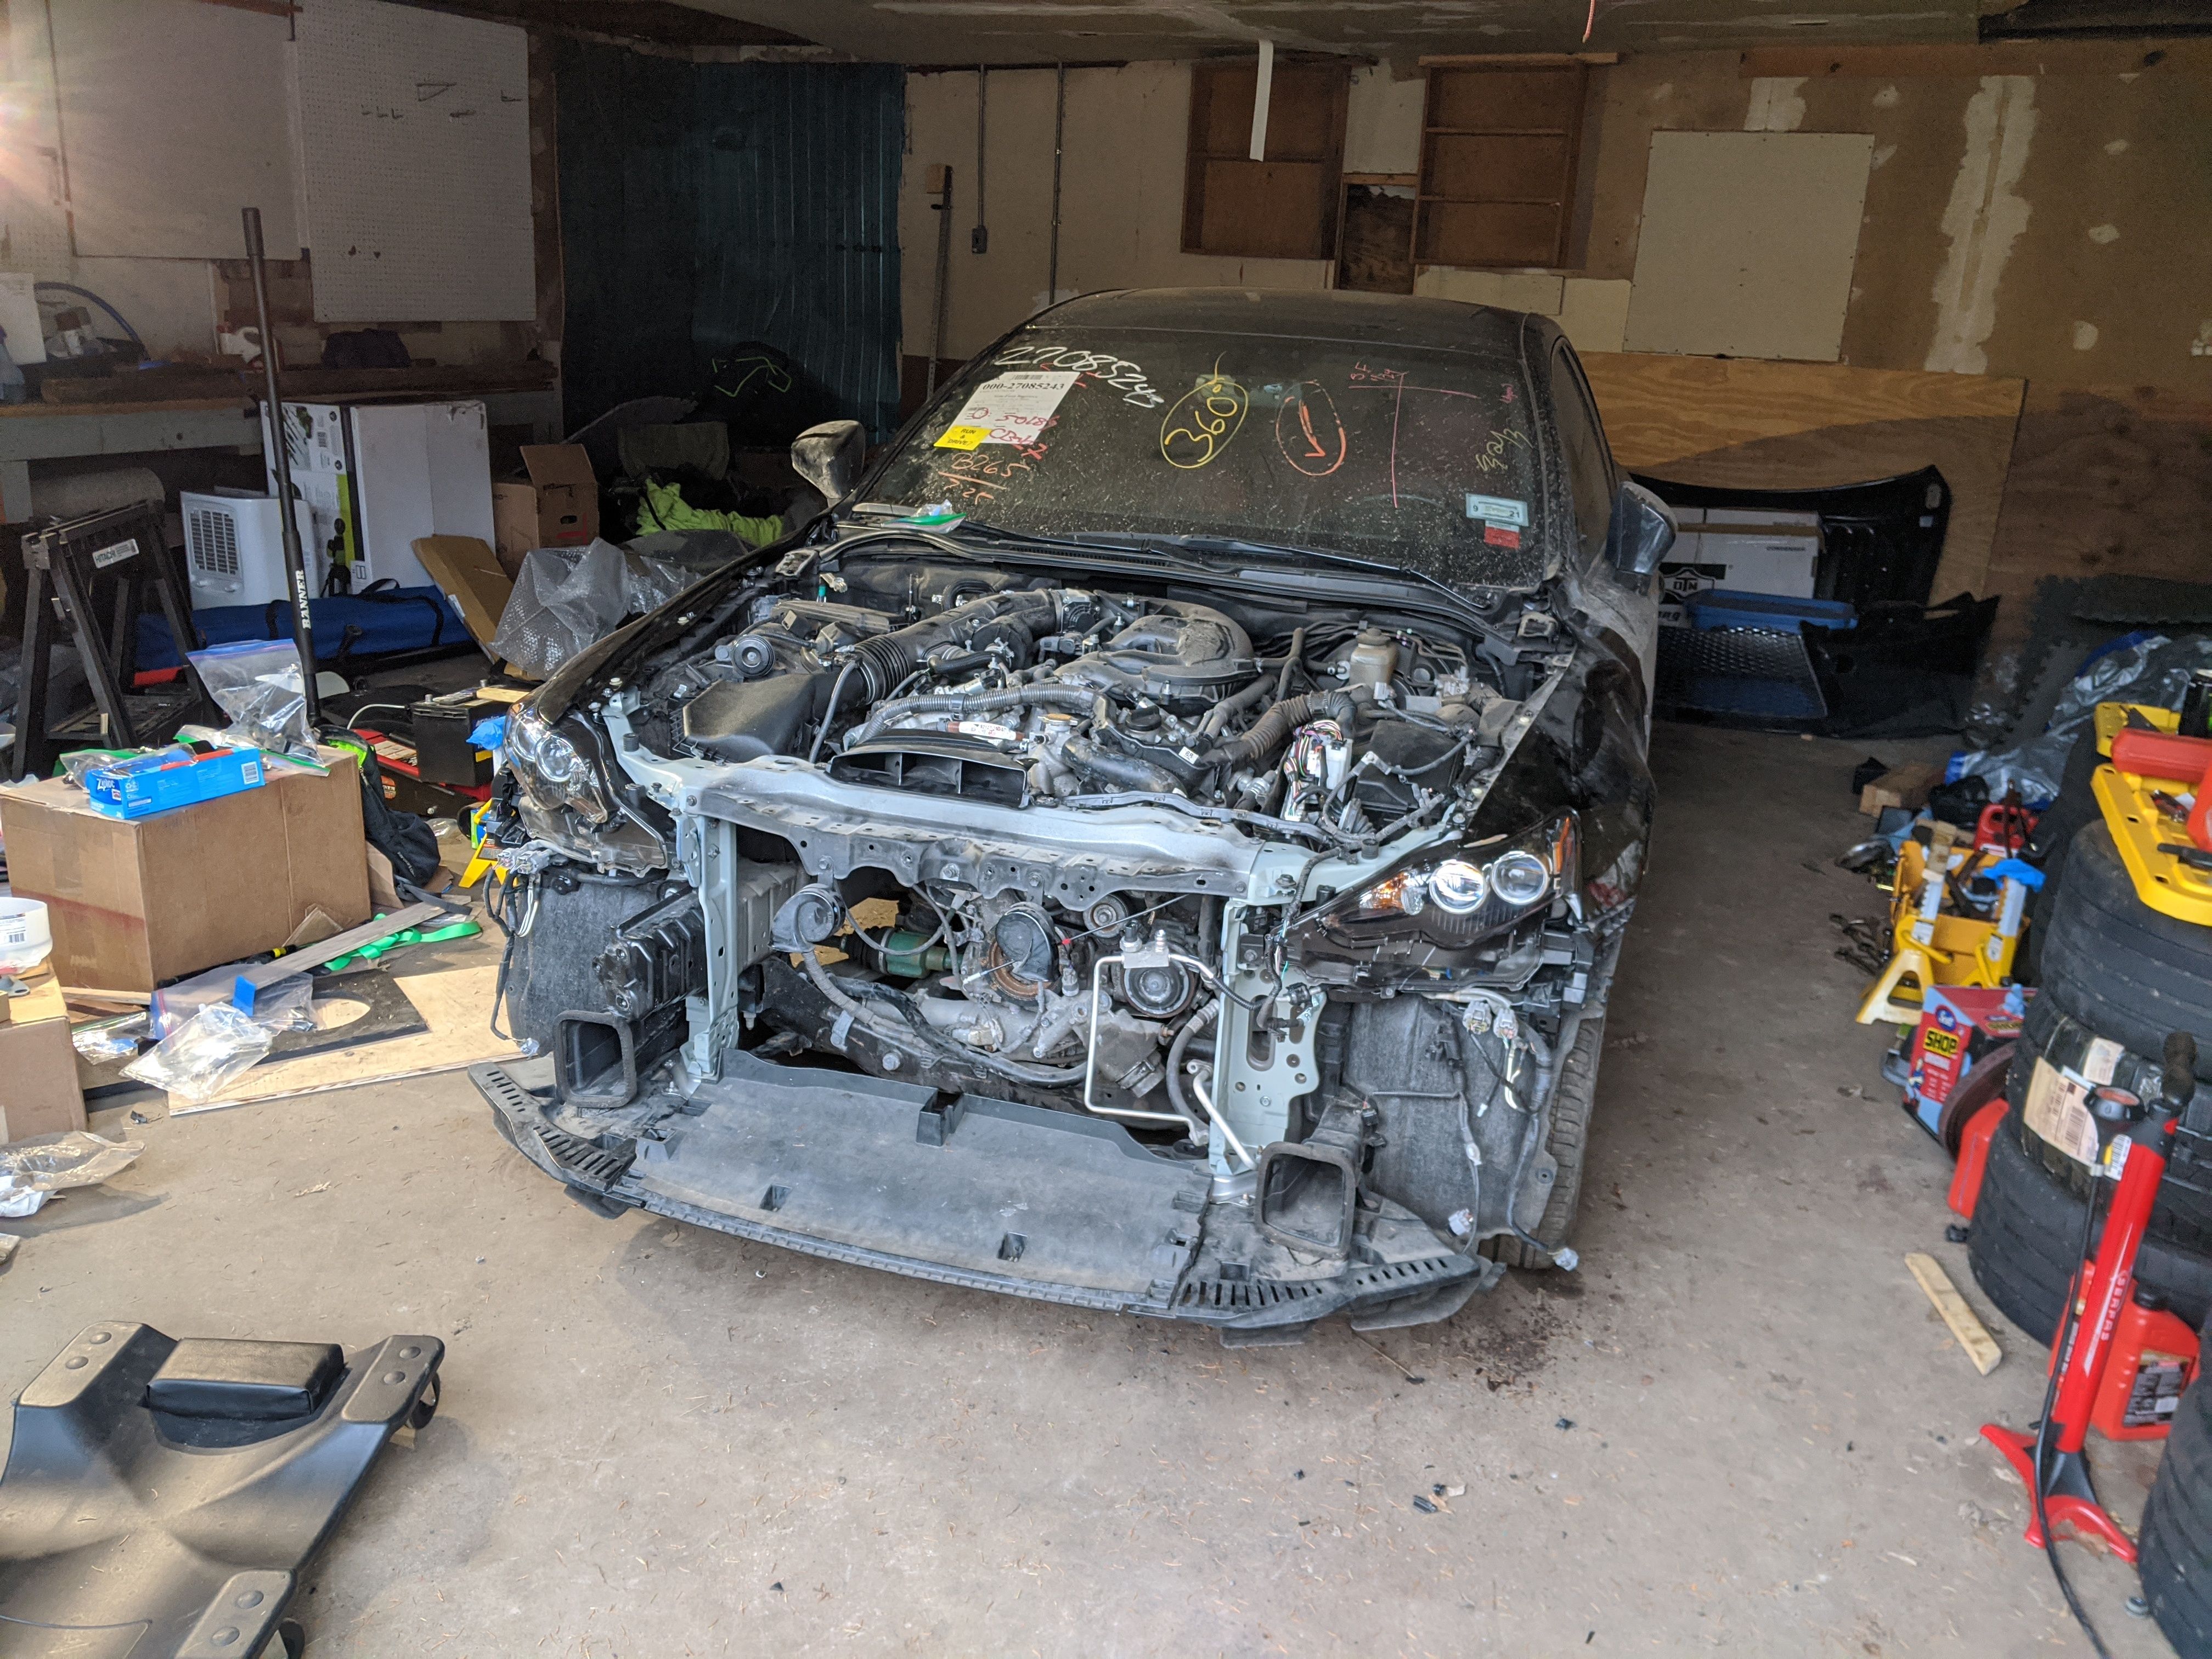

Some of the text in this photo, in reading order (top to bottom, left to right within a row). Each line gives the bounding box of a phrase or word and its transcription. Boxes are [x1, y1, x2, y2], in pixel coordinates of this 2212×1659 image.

[982, 382, 1065, 391] 000-27085243
[296, 570, 312, 629] BANNER
[96, 777, 115, 792] Ziploc
[1926, 1029, 1959, 1053] SHOP
